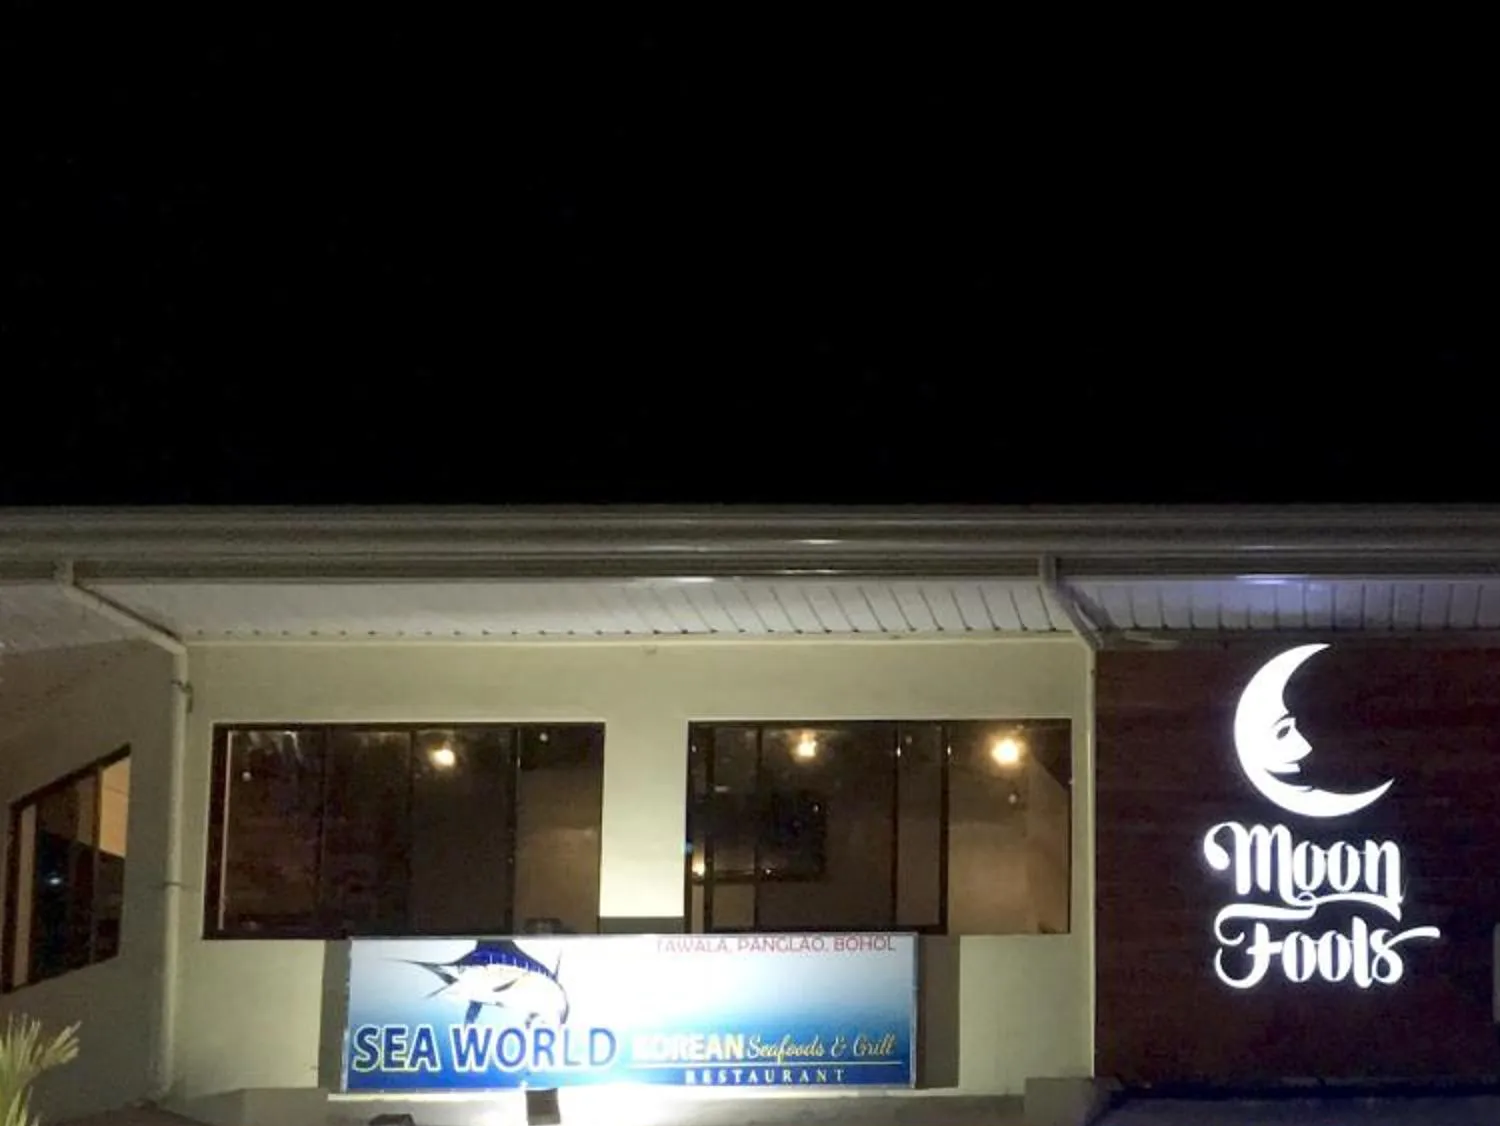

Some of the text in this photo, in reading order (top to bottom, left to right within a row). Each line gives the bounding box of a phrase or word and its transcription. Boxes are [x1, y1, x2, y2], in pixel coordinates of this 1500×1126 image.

[1204, 821, 1403, 919] Moon
[834, 936, 897, 952] BOHOL
[1214, 903, 1441, 989] Fools
[354, 1025, 617, 1071] SEA WORLD
[632, 1034, 744, 1060] KOREAN
[746, 1033, 824, 1064] Seafoods
[831, 1037, 846, 1057] &
[686, 1069, 846, 1084] RESTAURANT
